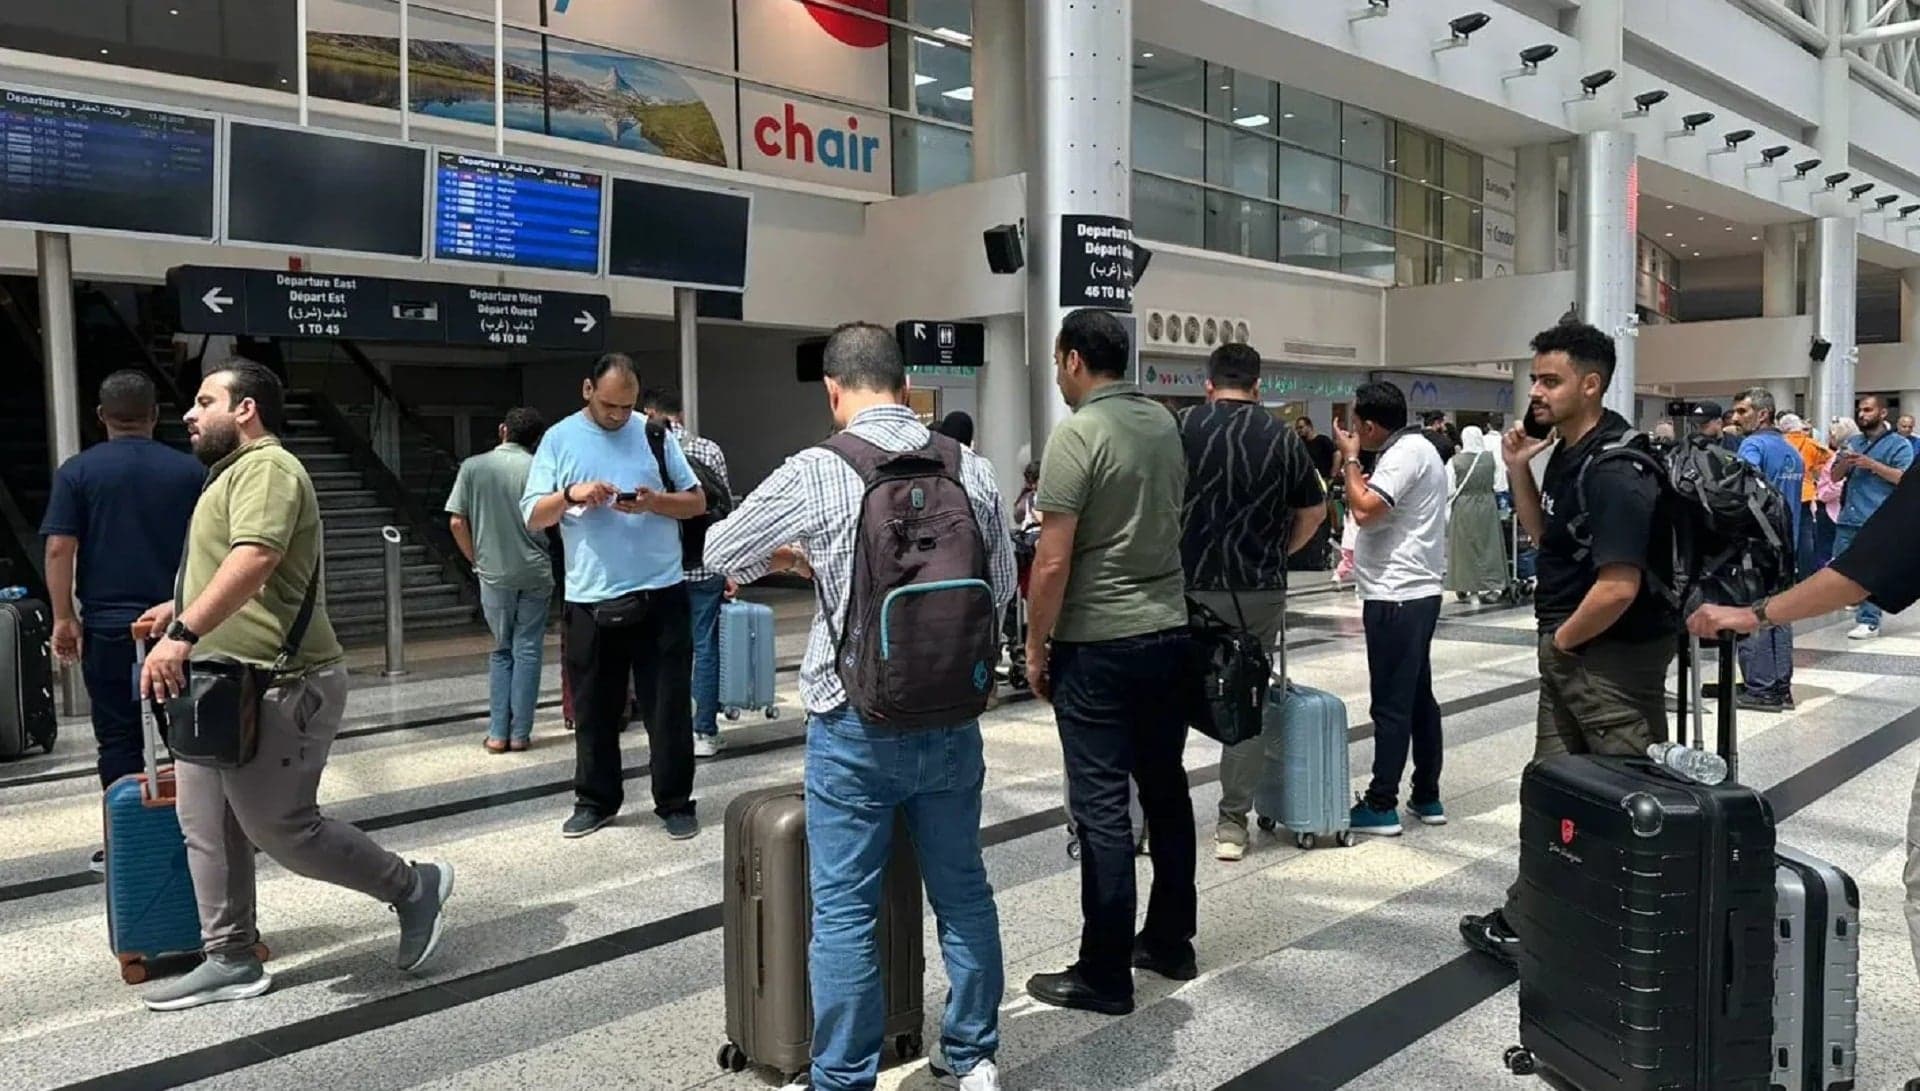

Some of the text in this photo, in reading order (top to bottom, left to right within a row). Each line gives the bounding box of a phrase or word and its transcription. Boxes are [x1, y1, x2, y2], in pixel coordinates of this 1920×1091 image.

[6, 92, 66, 109] Departures
[753, 102, 880, 173] chair
[458, 156, 500, 169] Departures
[1085, 242, 1121, 258] Départ
[1090, 261, 1121, 281] (غرب)
[276, 273, 357, 290] Departure East
[289, 290, 346, 304] Départ Est
[469, 288, 543, 305] Departure West
[1084, 285, 1100, 298] 46
[1101, 286, 1114, 298] TO
[288, 306, 348, 321] ذهاب (شرق)
[477, 304, 538, 317] Départ Ouest
[298, 323, 341, 336] 1 TO 45
[480, 318, 535, 333] ذهاب (غرب)
[488, 332, 502, 344] 46
[502, 333, 515, 344] TO
